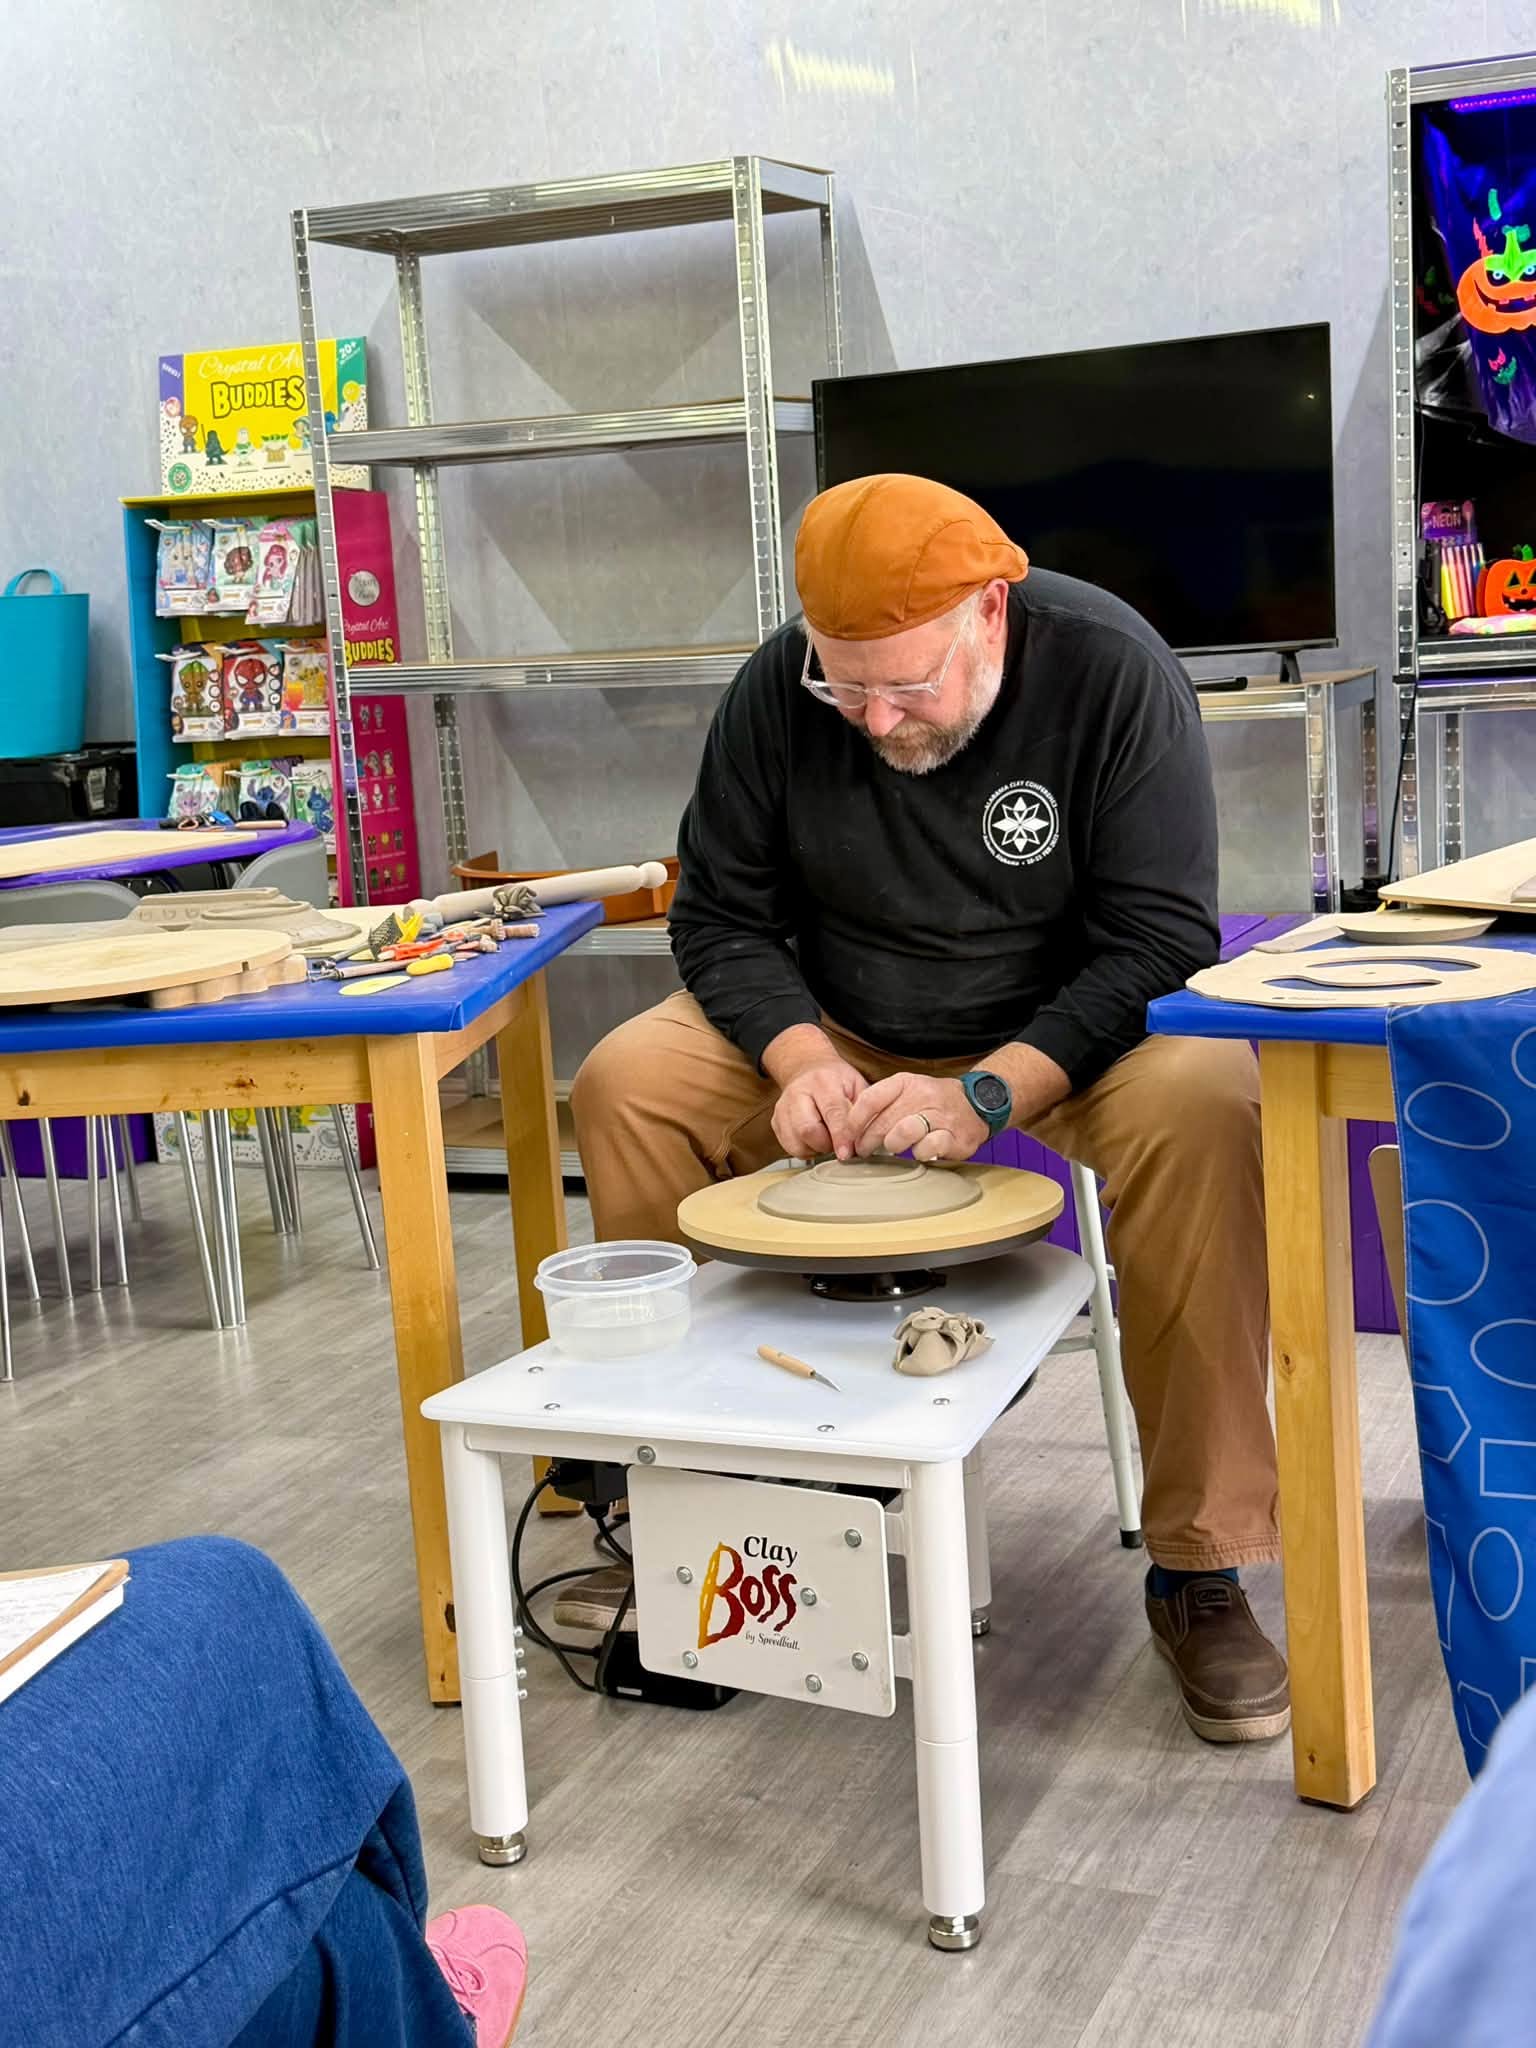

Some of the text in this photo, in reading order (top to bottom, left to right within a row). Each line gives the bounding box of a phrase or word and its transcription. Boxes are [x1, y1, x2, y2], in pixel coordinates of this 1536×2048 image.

[198, 354, 267, 380] Crystal
[267, 347, 302, 374] Ar
[210, 375, 306, 419] BUDDIES
[344, 636, 396, 669] BUDDIES
[743, 1535, 798, 1568] Clay
[745, 1630, 755, 1644] by
